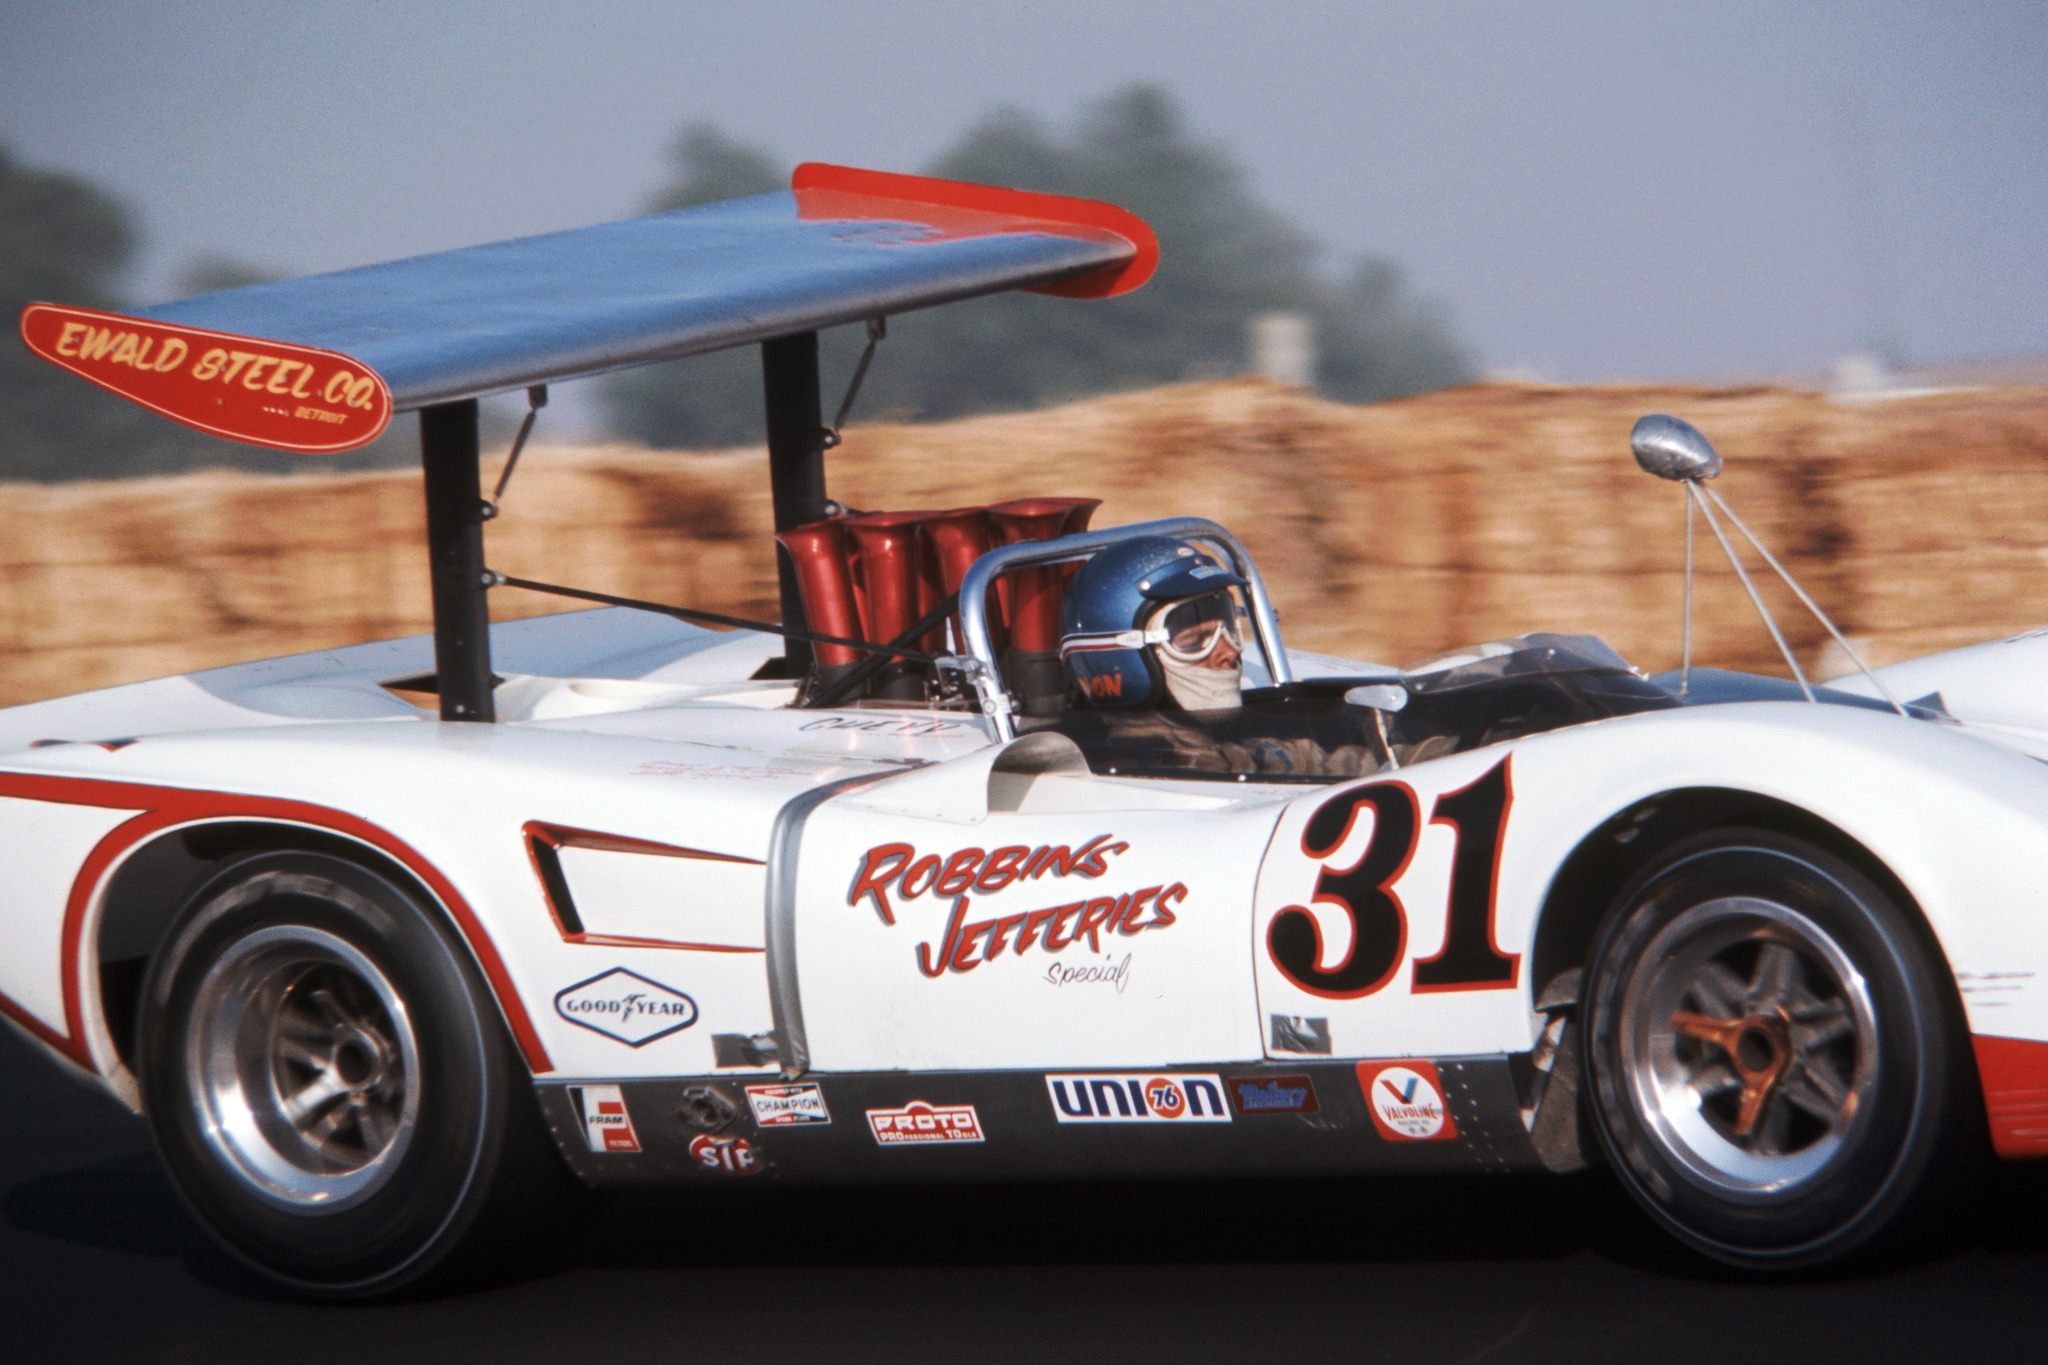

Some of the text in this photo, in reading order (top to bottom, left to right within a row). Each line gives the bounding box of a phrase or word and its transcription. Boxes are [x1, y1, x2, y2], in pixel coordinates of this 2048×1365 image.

[56, 322, 188, 372] EWALD
[192, 348, 314, 399] STEEL
[294, 406, 348, 425] DETROIT
[847, 834, 1130, 926] ROBBINS
[1266, 750, 1522, 1000] 31
[914, 882, 1188, 978] JEFFERIES
[1043, 953, 1132, 994] Special
[756, 1097, 820, 1114] CHAMPION
[1149, 1085, 1178, 1110] 76
[589, 1115, 624, 1125] FRAM
[874, 1113, 974, 1131] PROTO
[1382, 1103, 1437, 1121] VALVOLINE
